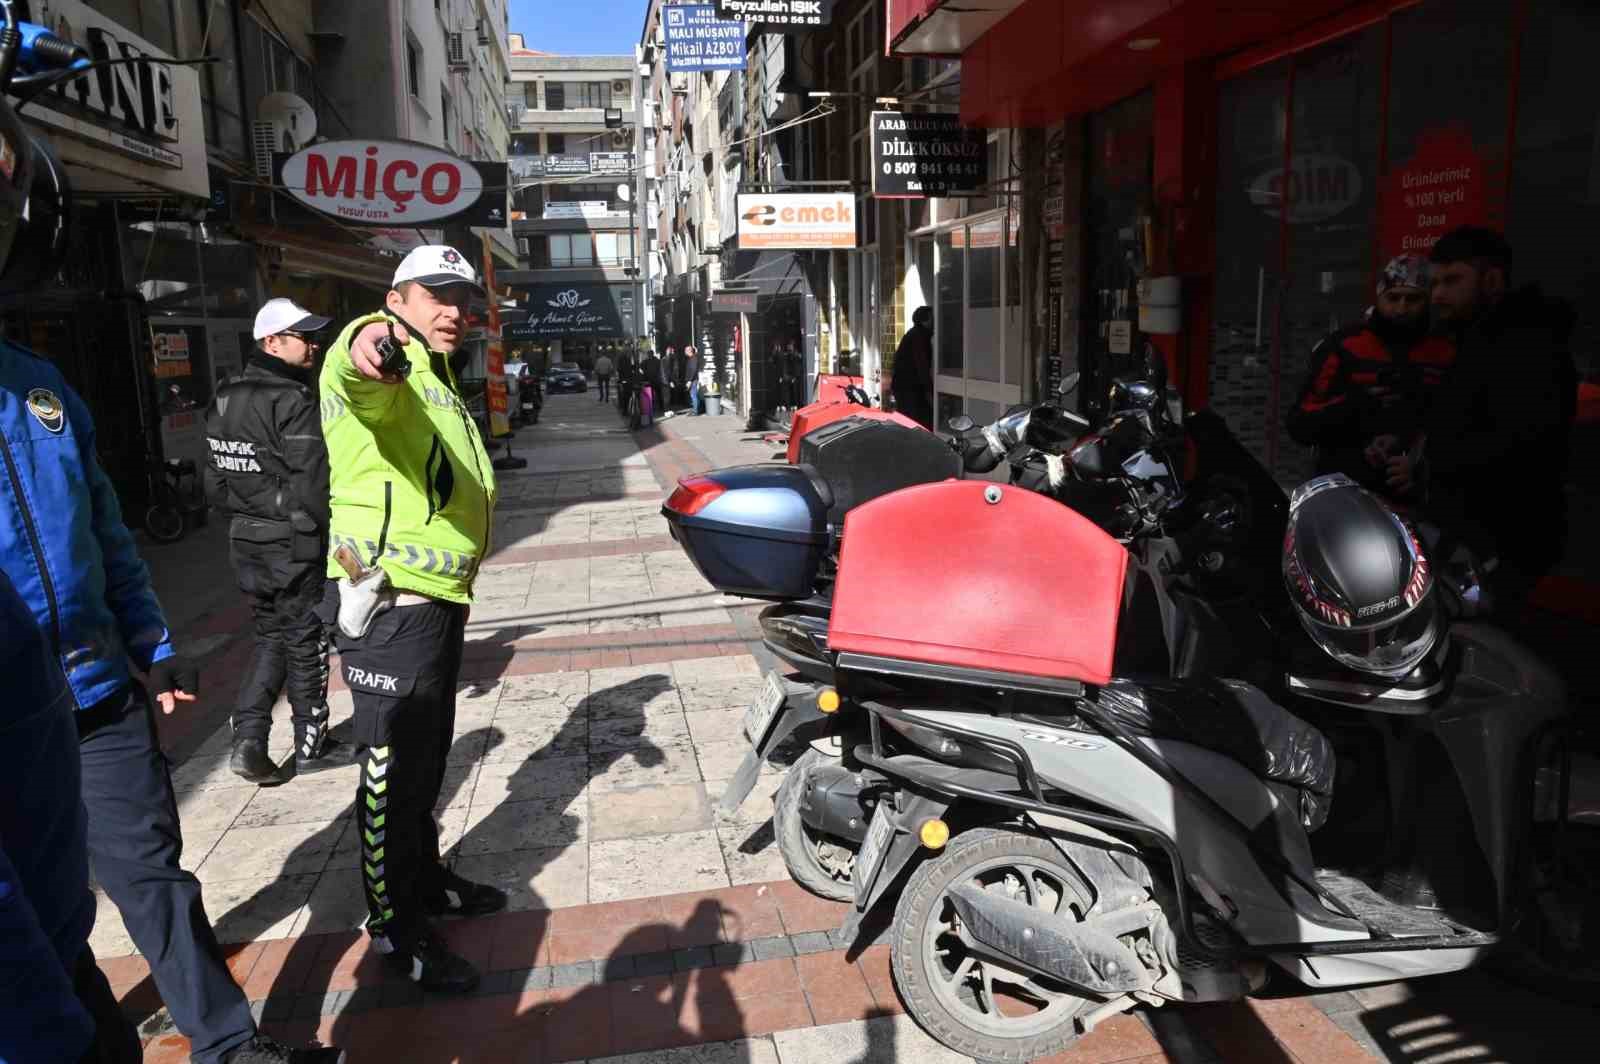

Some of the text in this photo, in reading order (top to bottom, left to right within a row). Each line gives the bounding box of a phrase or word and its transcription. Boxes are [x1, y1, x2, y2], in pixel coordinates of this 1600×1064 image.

[671, 41, 741, 55] Mikail AZBOY
[881, 137, 928, 156] DİLEK
[883, 162, 892, 174] 0
[894, 162, 917, 174] 507
[1437, 186, 1465, 207] Yerli
[367, 208, 389, 219] USTA
[779, 200, 851, 223] emek
[1417, 213, 1447, 228] Dana
